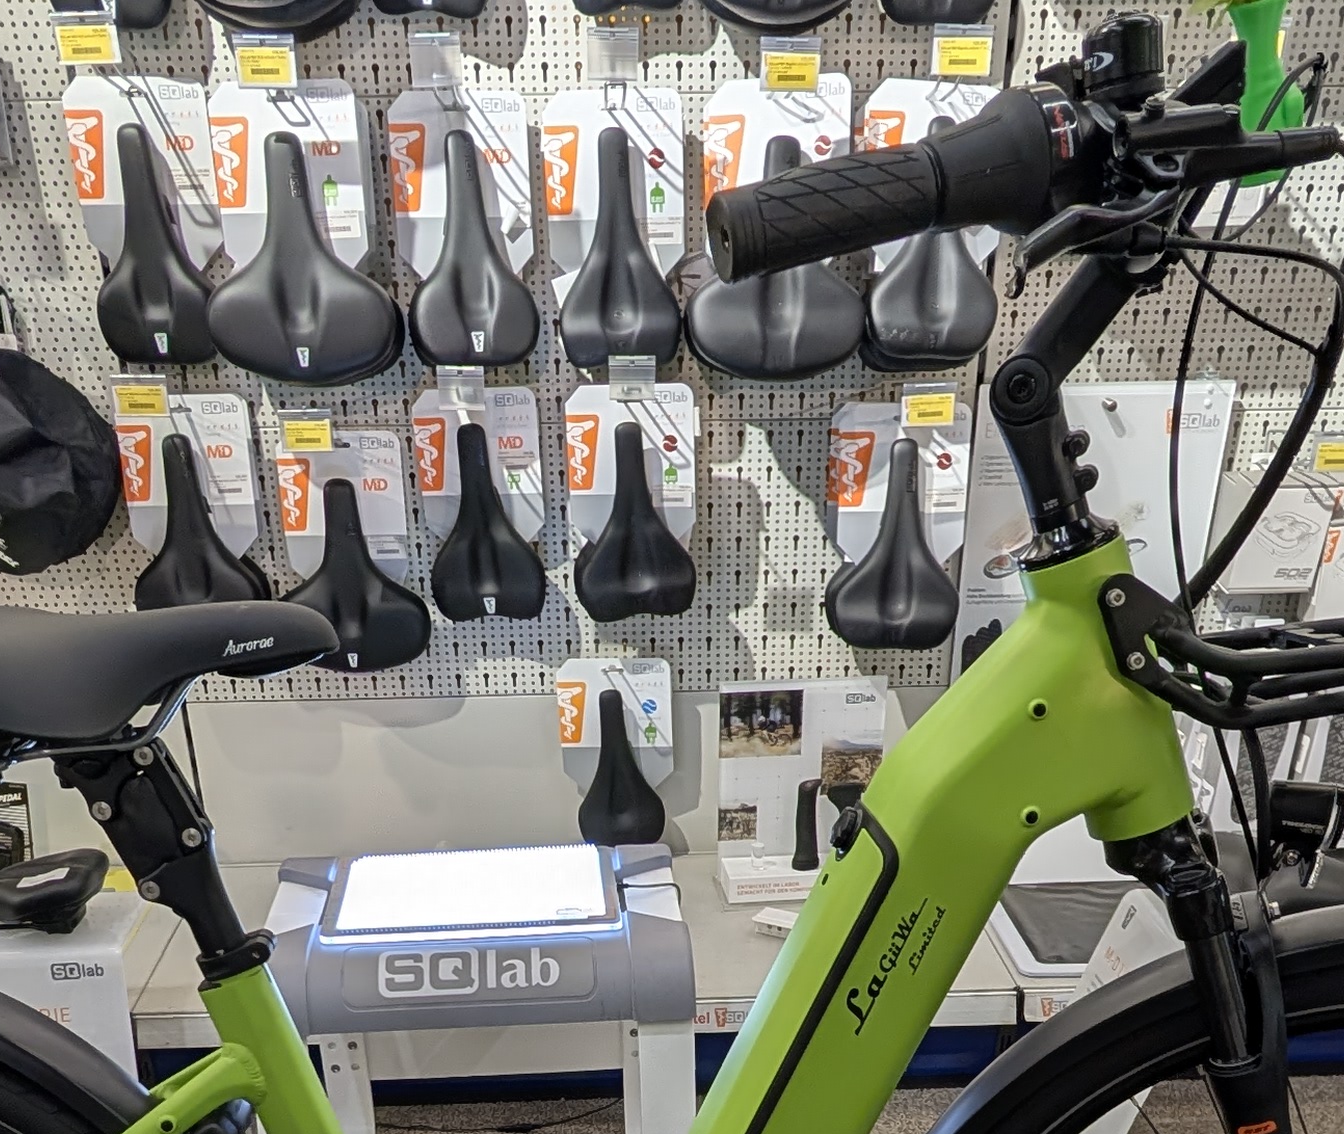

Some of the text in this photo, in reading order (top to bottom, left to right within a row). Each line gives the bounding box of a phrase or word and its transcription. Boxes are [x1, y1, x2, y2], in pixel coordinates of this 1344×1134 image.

[159, 84, 199, 99] SQlab
[481, 98, 520, 113] SQlab
[495, 394, 530, 406] SQlab
[201, 401, 238, 415] SQlab
[1180, 414, 1221, 429] SQlab
[359, 437, 395, 449] SQlab
[223, 636, 275, 658] Aurorae
[846, 693, 876, 704] SQlab
[908, 906, 946, 976] Limited
[50, 963, 104, 981] SQlab
[378, 947, 560, 998] SQlab
